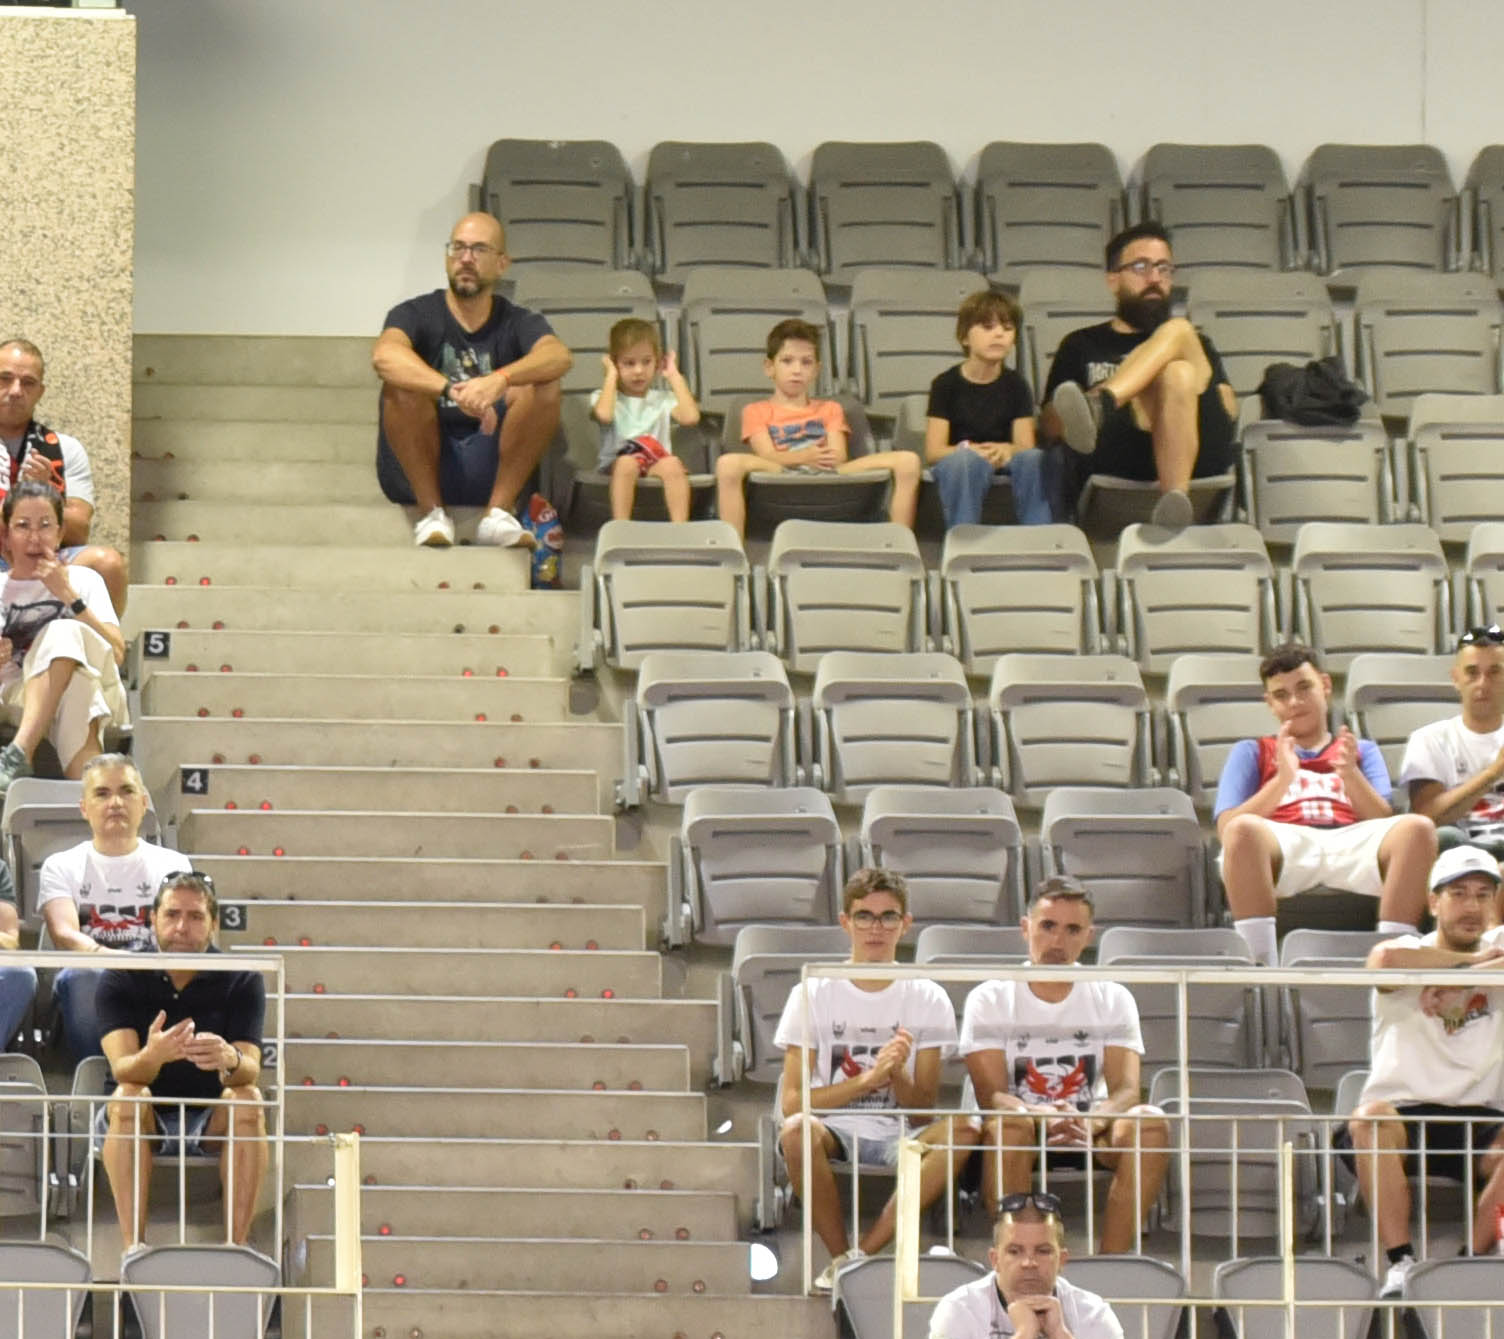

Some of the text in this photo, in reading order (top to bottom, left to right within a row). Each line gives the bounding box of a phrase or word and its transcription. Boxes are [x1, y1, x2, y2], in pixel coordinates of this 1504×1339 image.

[148, 633, 165, 654] 5
[186, 771, 203, 791] 4
[224, 906, 240, 927] 3
[262, 1047, 278, 1068] 2
